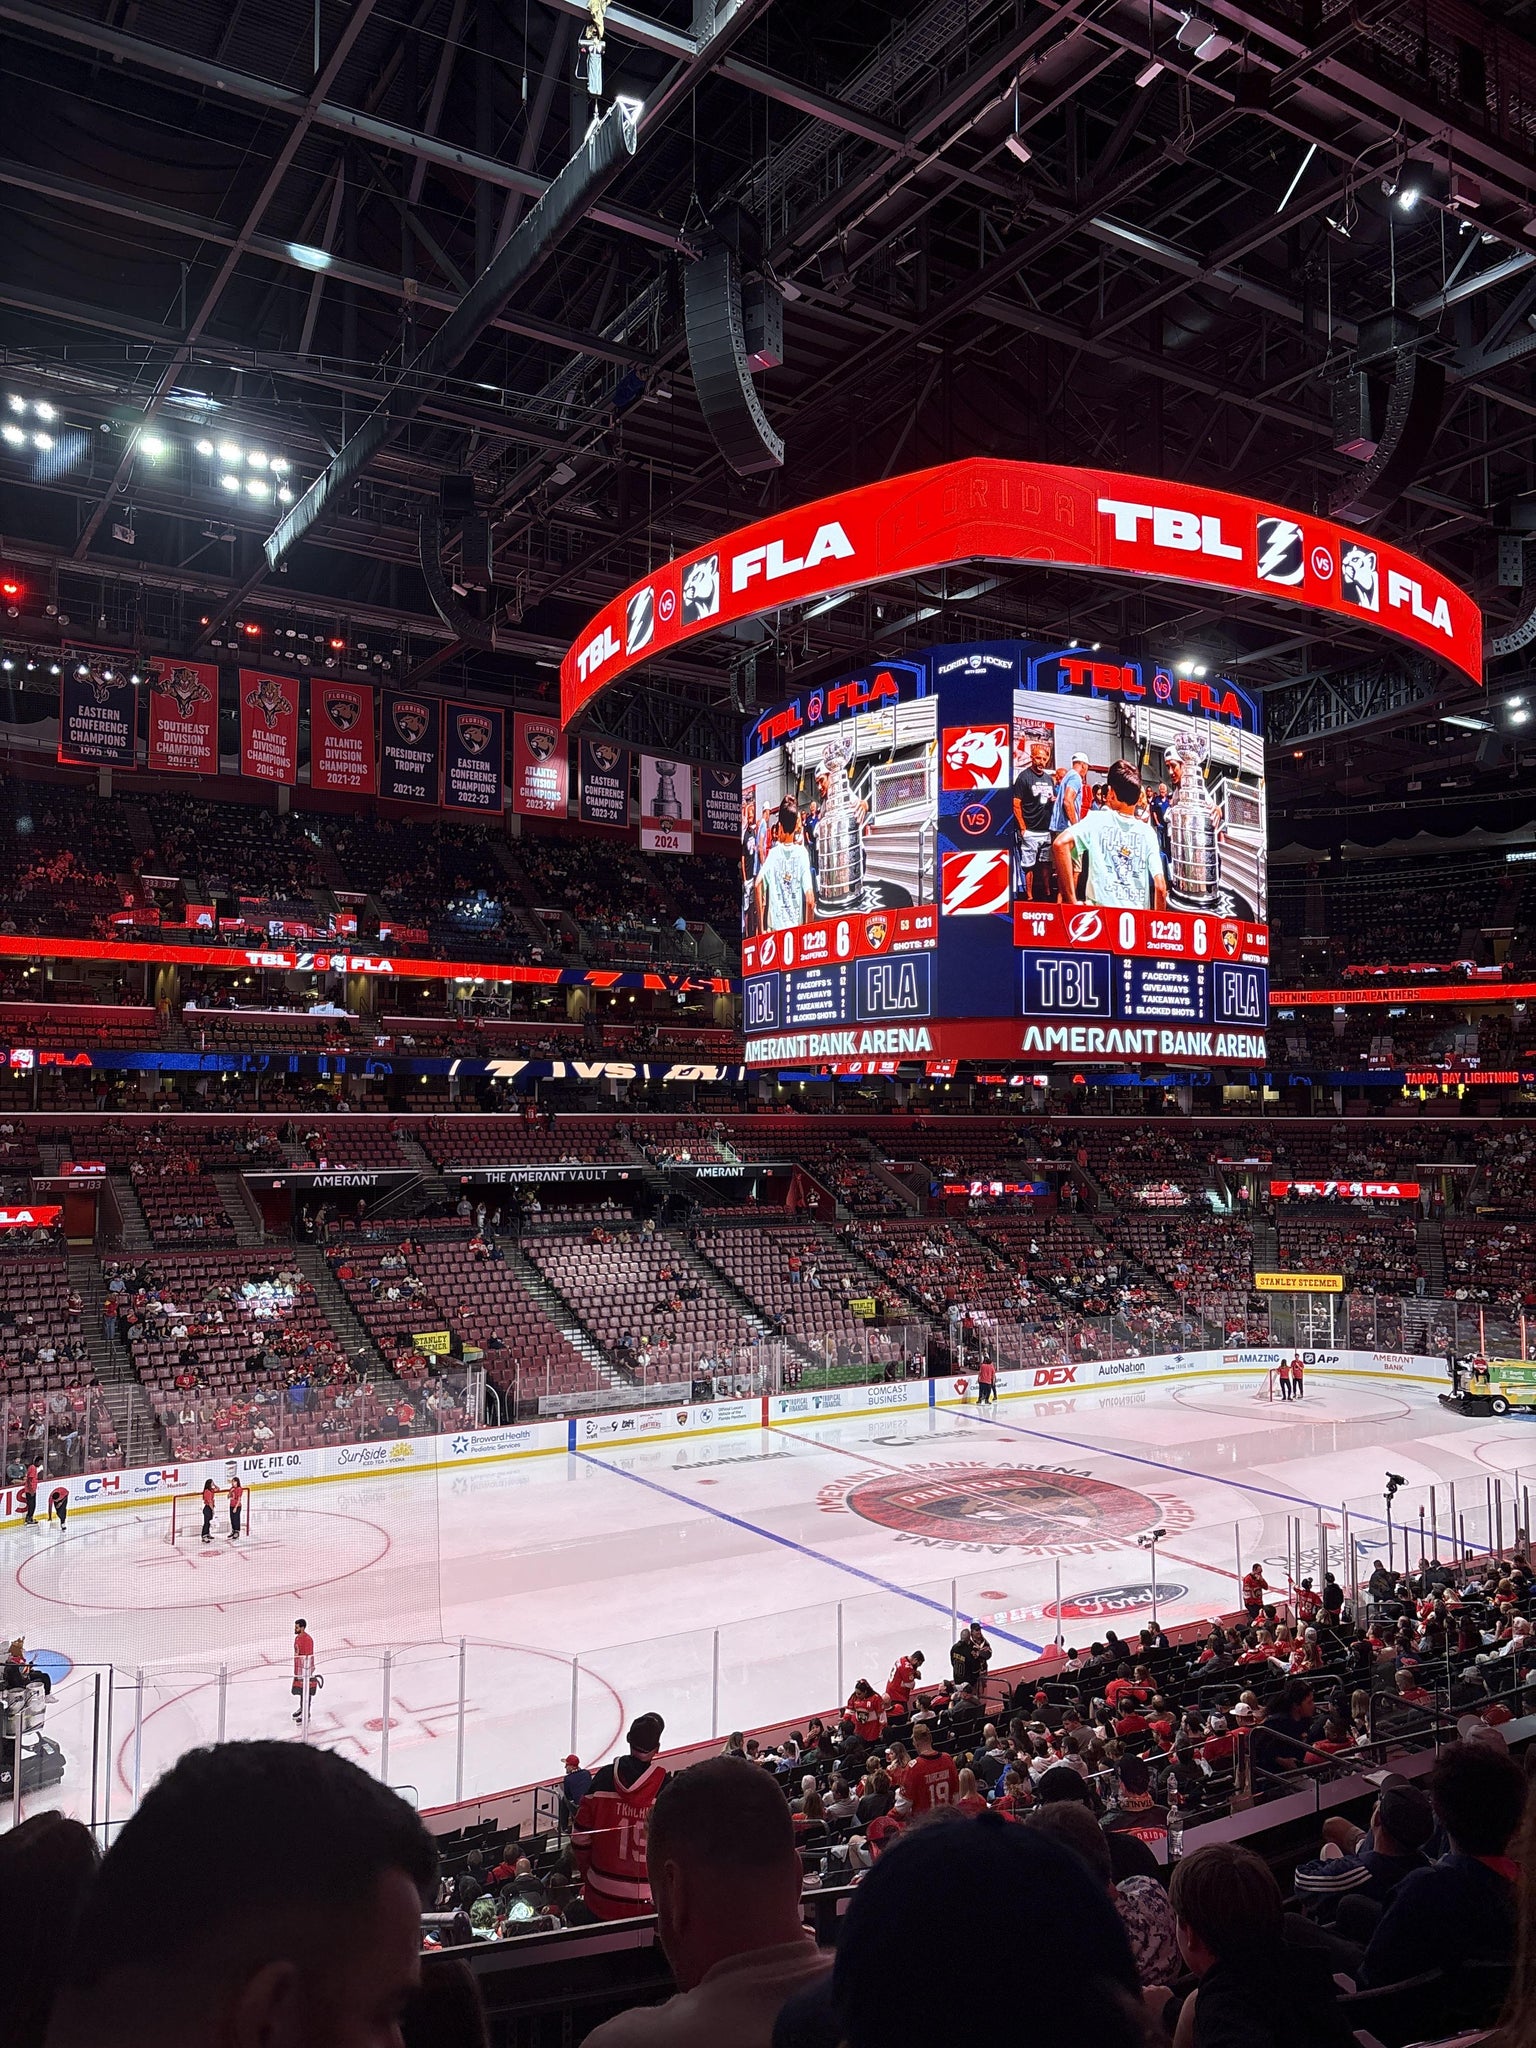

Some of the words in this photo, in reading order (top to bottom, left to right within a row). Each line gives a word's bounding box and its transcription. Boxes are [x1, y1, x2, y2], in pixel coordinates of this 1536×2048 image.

[1098, 498, 1242, 560] TBL
[731, 521, 855, 593] FLA
[1315, 555, 1330, 572] VS
[662, 596, 674, 612] VS
[1388, 569, 1453, 638] FLA
[577, 625, 620, 682] TBL
[938, 657, 969, 675] FLORIDA
[982, 655, 1013, 669] HOCKEY
[1060, 658, 1147, 695] TBL
[1178, 679, 1242, 720] FLA
[78, 704, 121, 721] EASTERN
[758, 707, 804, 744] TBL
[827, 671, 899, 715] FLA
[68, 716, 129, 735] CONFERENCE
[157, 719, 210, 735] SOUTHEAST
[70, 729, 127, 747] CHAMPIONS
[163, 731, 204, 745] DIVISION
[252, 728, 288, 746] ATLANTIC
[324, 736, 363, 750] ATLANTIC
[156, 741, 211, 757] CHAMPIONS
[253, 739, 286, 757] DIVISION
[325, 748, 362, 762] DIVISION
[385, 746, 435, 764] PRESIDENTS'
[247, 749, 291, 769] CHAMPIONS
[394, 759, 425, 774] TROPHY
[457, 757, 491, 772] EASTERN
[256, 763, 285, 779] 2015-16
[319, 760, 368, 775] CHAMPIONS
[524, 765, 558, 779] ATLANTIC
[327, 773, 361, 786] 2021-22
[450, 767, 498, 784] CONFERENCE
[525, 776, 557, 790] DIVISION
[590, 775, 620, 788] EASTERN
[393, 782, 426, 798] 2021-22
[451, 779, 496, 795] CHAMPIONS
[519, 787, 562, 802] CHAMPIONS
[584, 784, 625, 800] CONFERENCE
[457, 791, 490, 805] 2022-23
[585, 796, 624, 810] CHAMPIONS
[711, 790, 738, 801] EASTERN
[525, 799, 556, 812] 2023-24
[591, 807, 618, 820] 2023-24
[966, 813, 985, 826] VS
[712, 820, 738, 832] 2024-25
[654, 835, 679, 849] 2024
[1022, 911, 1054, 921] SHOTS
[1032, 920, 1046, 937] 14
[1118, 911, 1136, 950] 0
[1150, 920, 1182, 941] 12:29
[802, 929, 827, 951] 12:29
[836, 920, 850, 957] 6
[1193, 918, 1207, 956] 6
[783, 931, 794, 966] 0
[893, 940, 923, 951] SHOTS:
[1160, 942, 1184, 952] PERIOD
[245, 952, 292, 966] TBL
[350, 958, 394, 972] FLA
[808, 950, 829, 960] PERIOD
[1156, 961, 1176, 971] HITS
[796, 979, 827, 990] FACEOFFS
[1036, 959, 1099, 1008] TBL
[1142, 972, 1182, 983] FACEOFFS
[1182, 974, 1190, 983] %
[867, 962, 918, 1011] FLA
[1142, 983, 1190, 994] GIVEAWAYS
[796, 989, 832, 1001] GIVEAWAYS
[1141, 994, 1191, 1006] TAKEAWAYS
[1223, 971, 1260, 1018] FLA
[1270, 992, 1314, 1003] IGHTNING
[1328, 990, 1368, 1002] FLORIDA
[1370, 988, 1421, 1002] PANTHERS
[748, 981, 774, 1024] TBL
[795, 1000, 833, 1011] TAKEAWAYS
[816, 1010, 837, 1020] SHOTS
[1136, 1005, 1169, 1016] BLOCKED
[1169, 1007, 1196, 1017] SHOTS
[744, 1035, 809, 1063] AMERANT
[809, 1030, 858, 1058] BANK
[859, 1026, 933, 1054] ARENA
[1023, 1025, 1158, 1055] AMERANT
[1159, 1030, 1214, 1057] BANK
[1215, 1033, 1267, 1059] ARENA
[38, 1052, 93, 1066] FLA
[571, 1061, 638, 1079] VS
[1404, 1072, 1439, 1085] TAMPA
[1441, 1072, 1462, 1084] BAY
[1464, 1071, 1520, 1085] LIGHTNING
[485, 1172, 506, 1183] THE
[509, 1171, 567, 1183] AMERANT
[569, 1170, 609, 1182] VAULT
[695, 1166, 745, 1178] AMERANT
[36, 1181, 52, 1191] 132
[86, 1180, 102, 1190] 133
[312, 1175, 379, 1188] AMERANT
[1004, 1184, 1035, 1193] FLA
[1365, 1184, 1401, 1195] FLA
[1259, 1277, 1297, 1288] STANLEY
[1297, 1277, 1338, 1289] STEEMER
[415, 1334, 448, 1345] STANLEY
[1239, 1354, 1280, 1363] AMAZING
[1372, 1354, 1416, 1364] AMERANT
[1098, 1362, 1146, 1377] AutoNation
[1383, 1363, 1405, 1372] BANK
[1033, 1366, 1079, 1387] DEX
[867, 1384, 908, 1396] COMCAST
[868, 1394, 908, 1406] BUSINESS
[470, 1434, 505, 1445] Broward
[505, 1430, 531, 1441] Health
[470, 1444, 497, 1453] Pediatric
[499, 1441, 521, 1450] Services
[243, 1458, 267, 1471] LIVE.
[268, 1456, 285, 1468] FIT.
[286, 1454, 302, 1466] GO.
[337, 1446, 388, 1466] Surfside
[671, 1450, 796, 1471] AutoNation
[84, 1476, 120, 1494] CH
[144, 1469, 179, 1486] CH
[74, 1493, 99, 1502] Cooper
[107, 1488, 130, 1497] Hunter
[134, 1485, 158, 1493] Cooper
[815, 1467, 887, 1514] AMERANT
[905, 1461, 987, 1470] BANK
[995, 1461, 1094, 1478] ARENA
[900, 1477, 1028, 1505] PANTHERS
[1074, 1588, 1164, 1616] Ford
